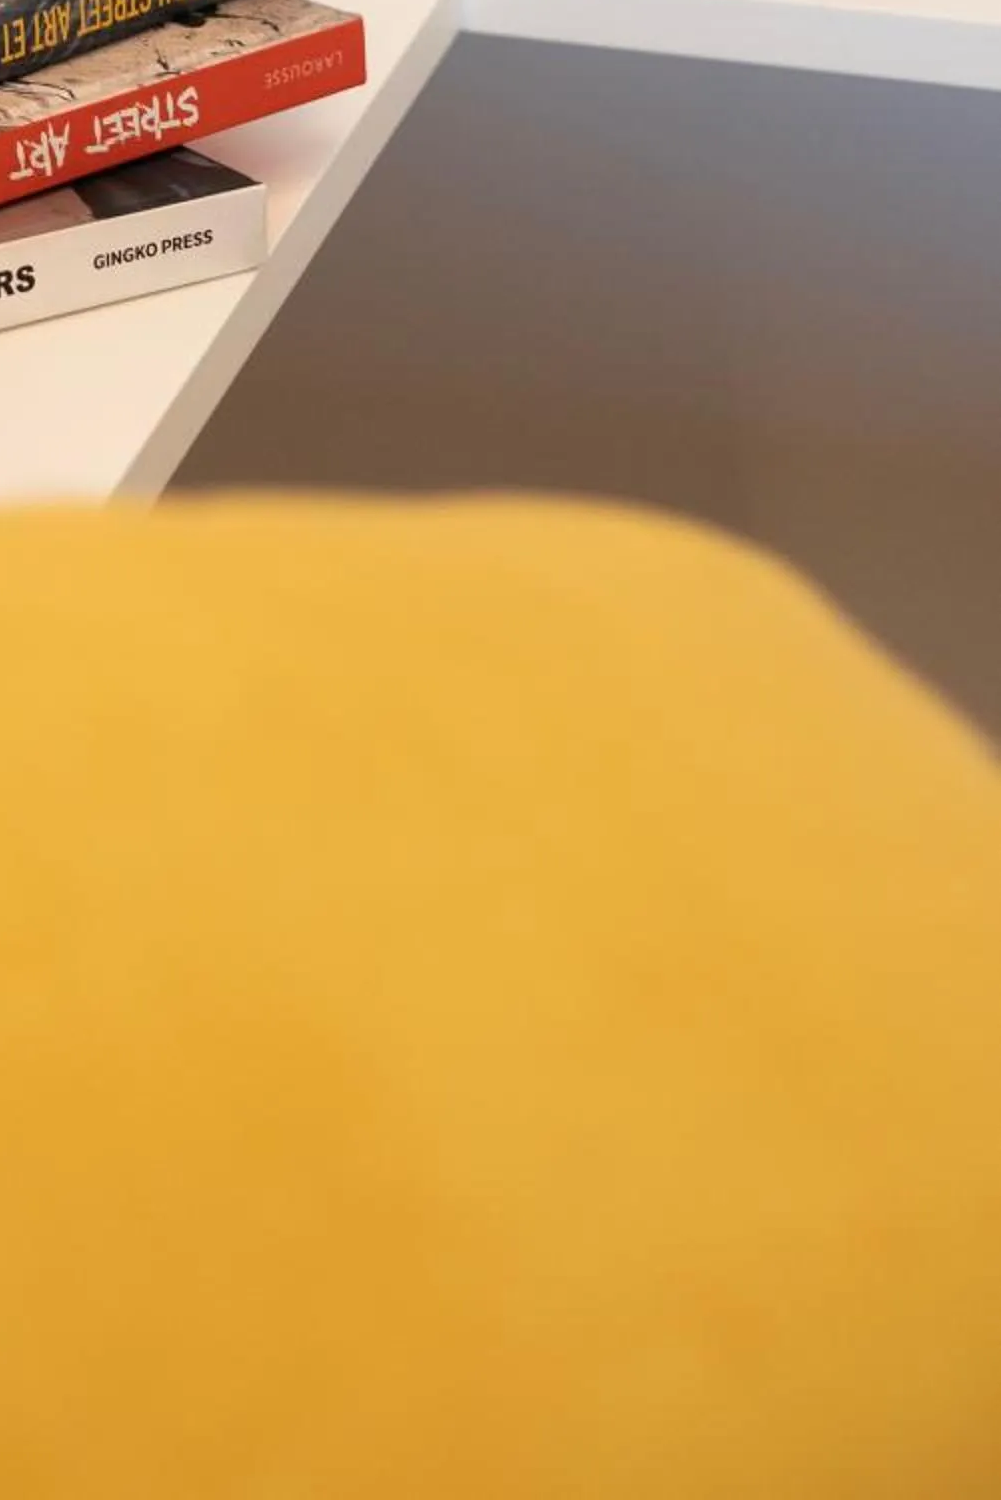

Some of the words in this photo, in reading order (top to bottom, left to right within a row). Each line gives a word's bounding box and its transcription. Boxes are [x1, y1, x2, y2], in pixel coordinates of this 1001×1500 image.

[32, 8, 71, 53] ART
[263, 49, 343, 91] LAROUSSE
[84, 85, 200, 155] STREET
[9, 120, 72, 182] ART
[93, 241, 158, 271] GINGKO
[160, 228, 214, 257] PRESS
